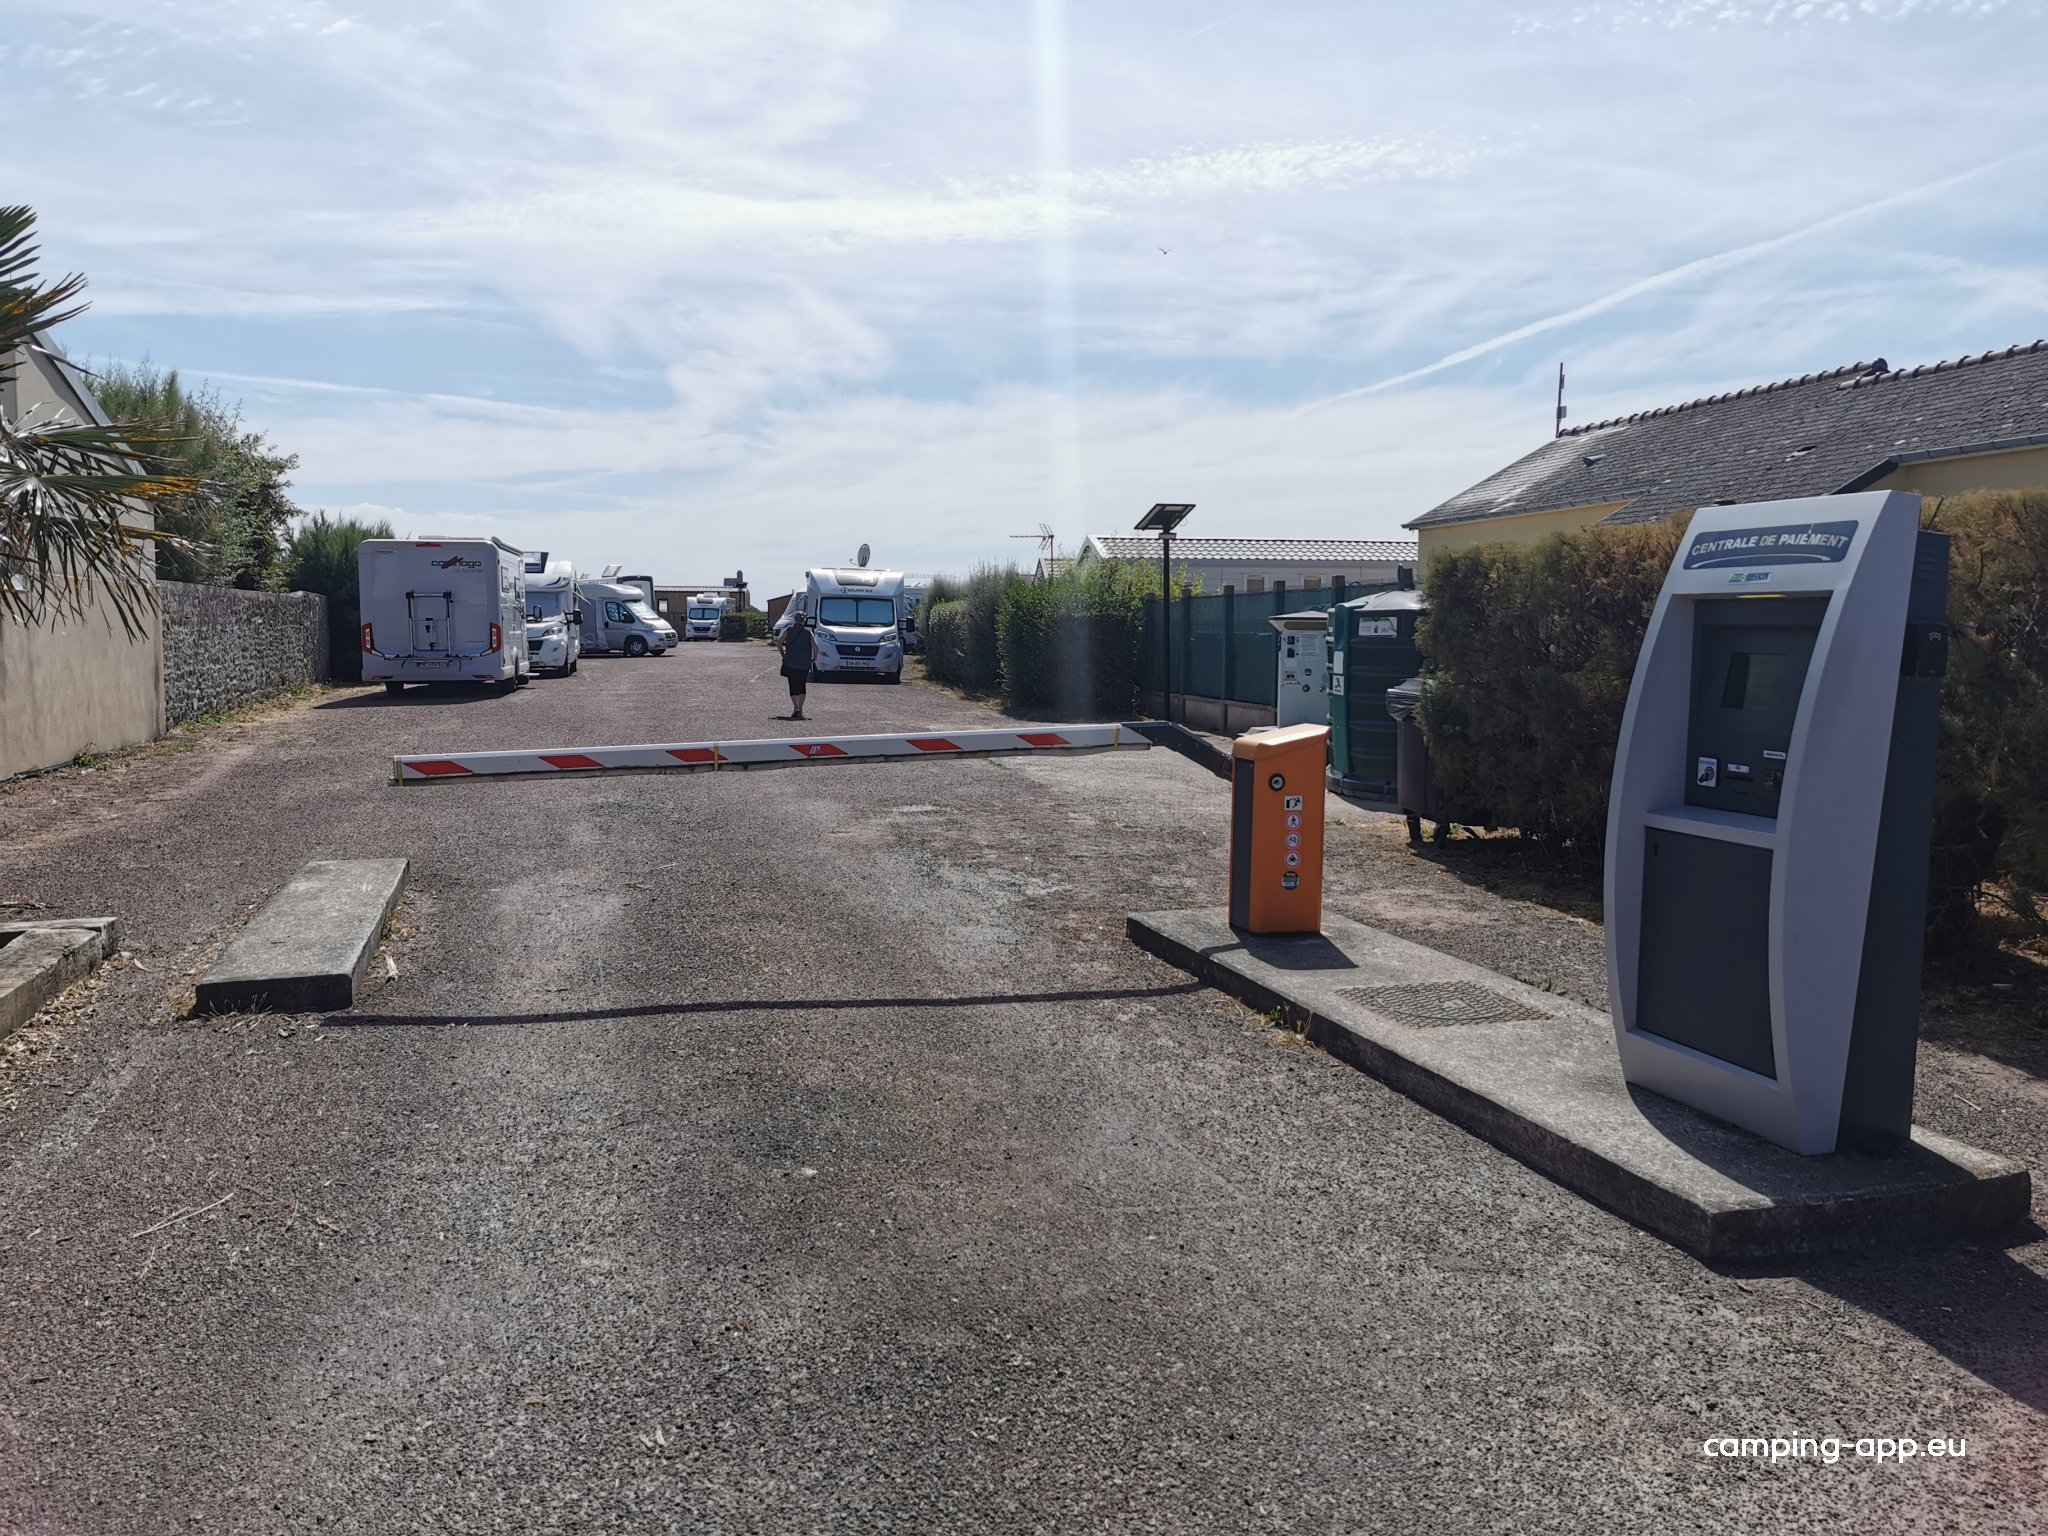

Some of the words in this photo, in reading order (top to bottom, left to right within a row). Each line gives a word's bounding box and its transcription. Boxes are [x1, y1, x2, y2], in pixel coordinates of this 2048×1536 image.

[1691, 536, 1759, 556] CENTRALE
[1758, 534, 1776, 546] DE
[1778, 533, 1849, 548] PAIEMENT
[431, 557, 482, 569] cahago
